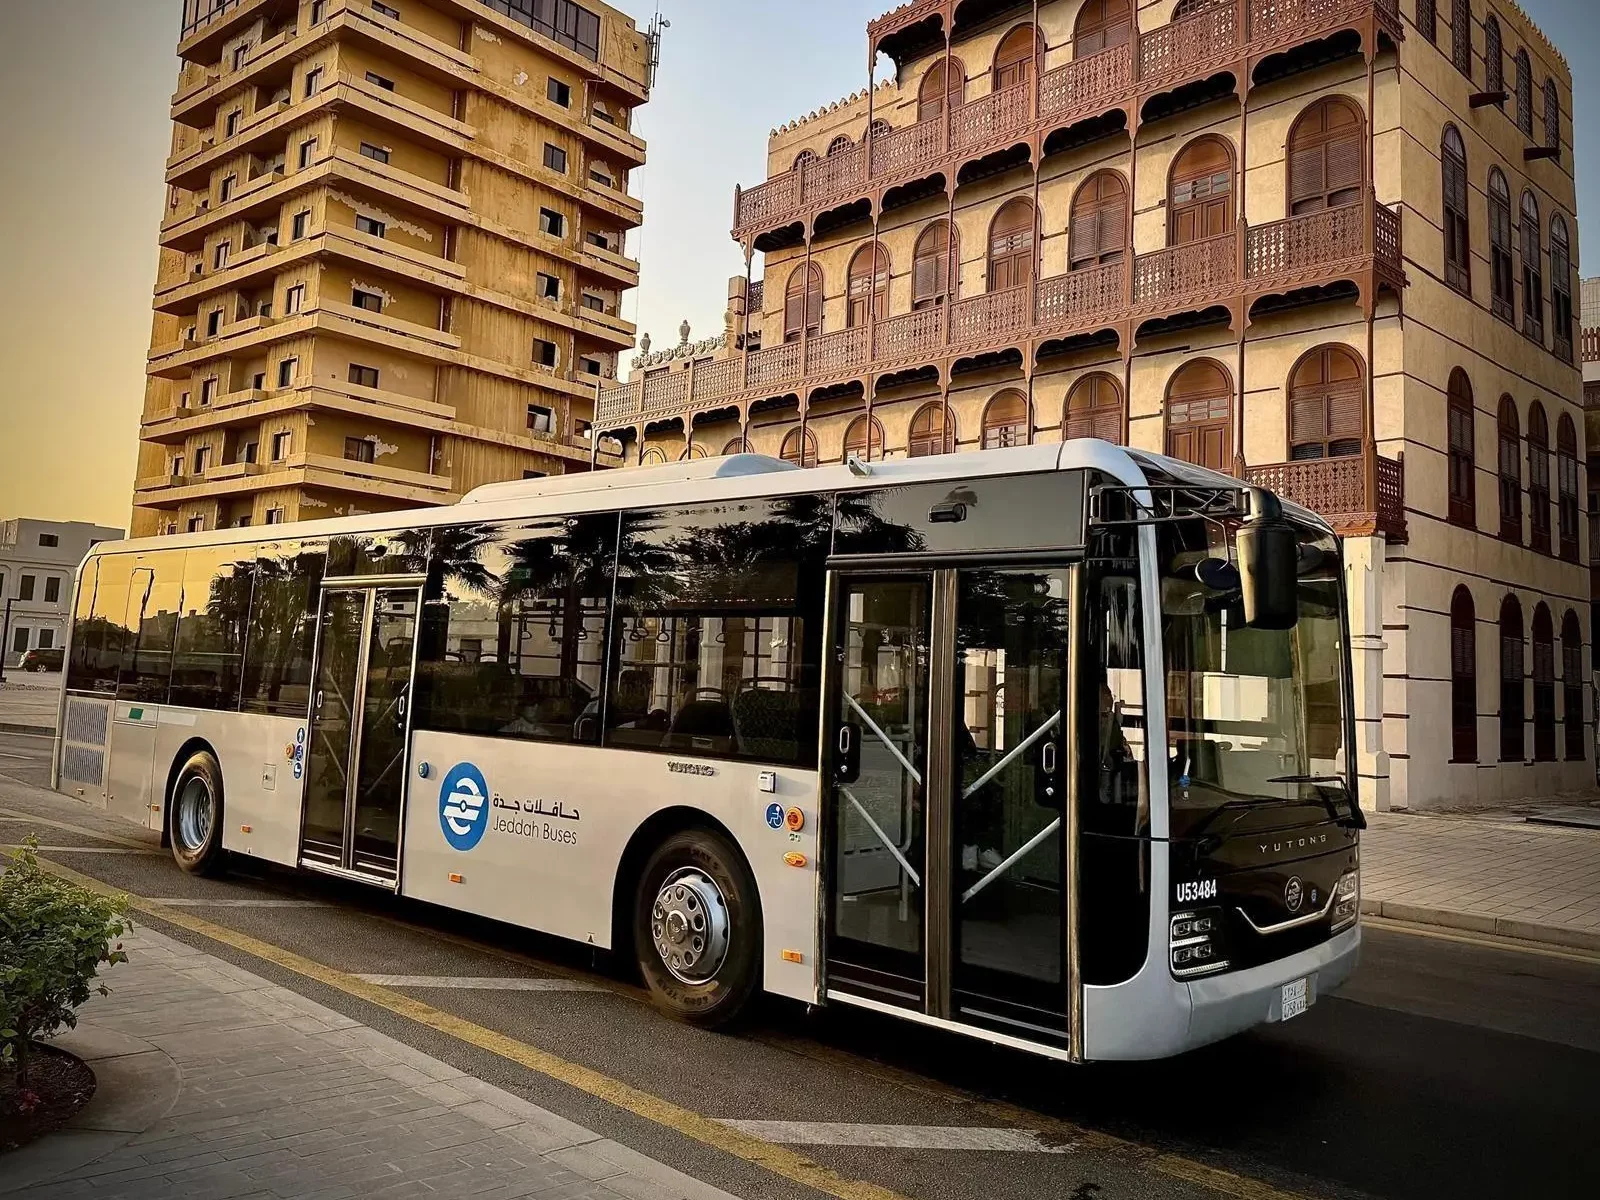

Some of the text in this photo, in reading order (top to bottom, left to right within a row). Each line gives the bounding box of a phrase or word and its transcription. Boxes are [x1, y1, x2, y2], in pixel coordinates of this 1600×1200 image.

[667, 761, 715, 777] YUTONG
[493, 793, 580, 820] حافلات جدة
[493, 816, 577, 845] Jeddah Buses
[1260, 834, 1326, 853] YUTONG
[1176, 878, 1217, 903] U53484
